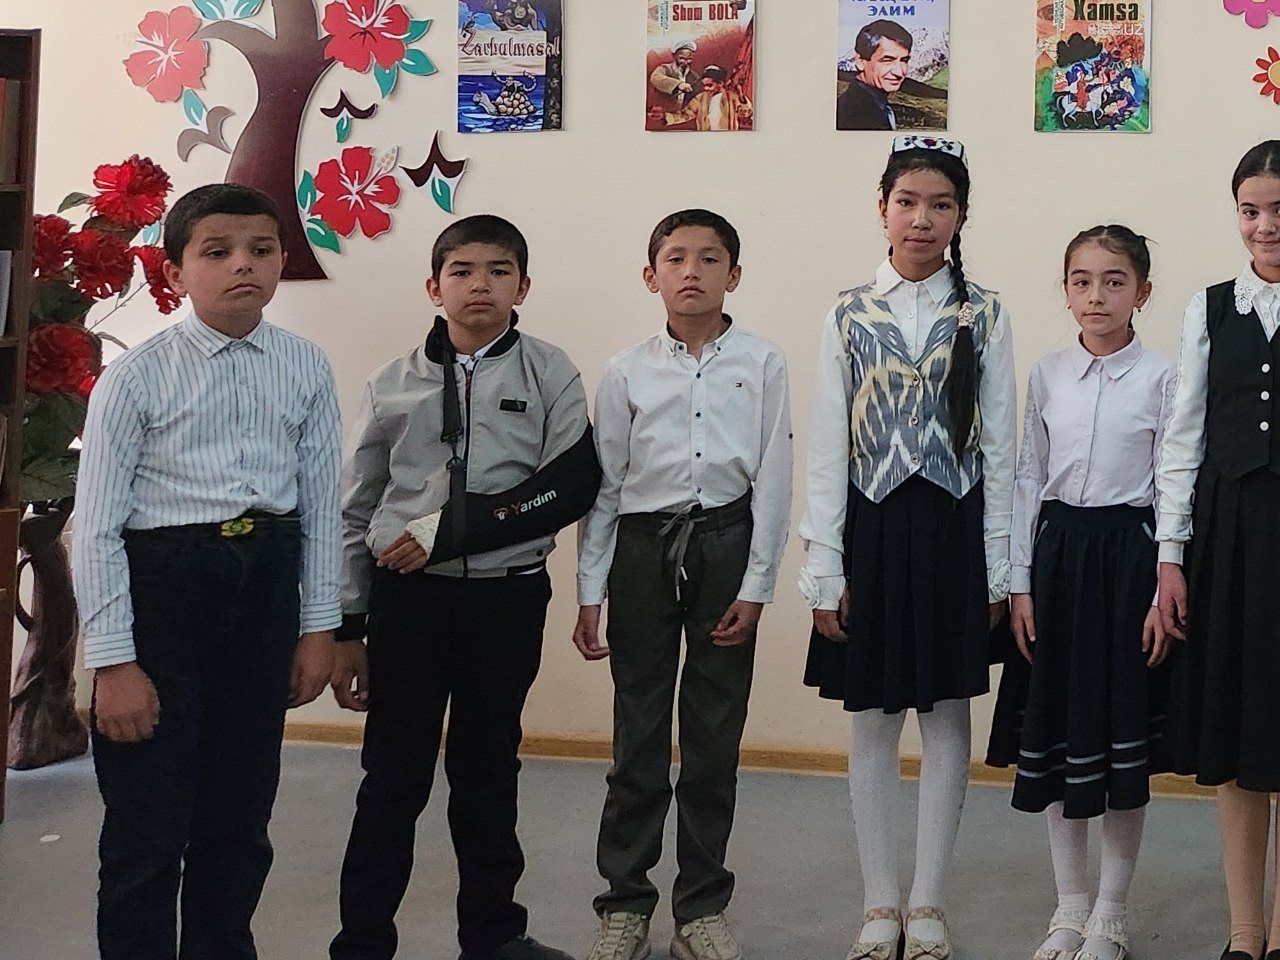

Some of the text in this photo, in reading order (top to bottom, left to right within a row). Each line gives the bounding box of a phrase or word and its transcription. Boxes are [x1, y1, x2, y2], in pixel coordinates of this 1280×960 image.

[672, 4, 703, 21] Shum
[709, 2, 739, 20] BOLA
[867, 5, 916, 16] ЭЛИМ
[1073, 0, 1139, 21] Xamsa
